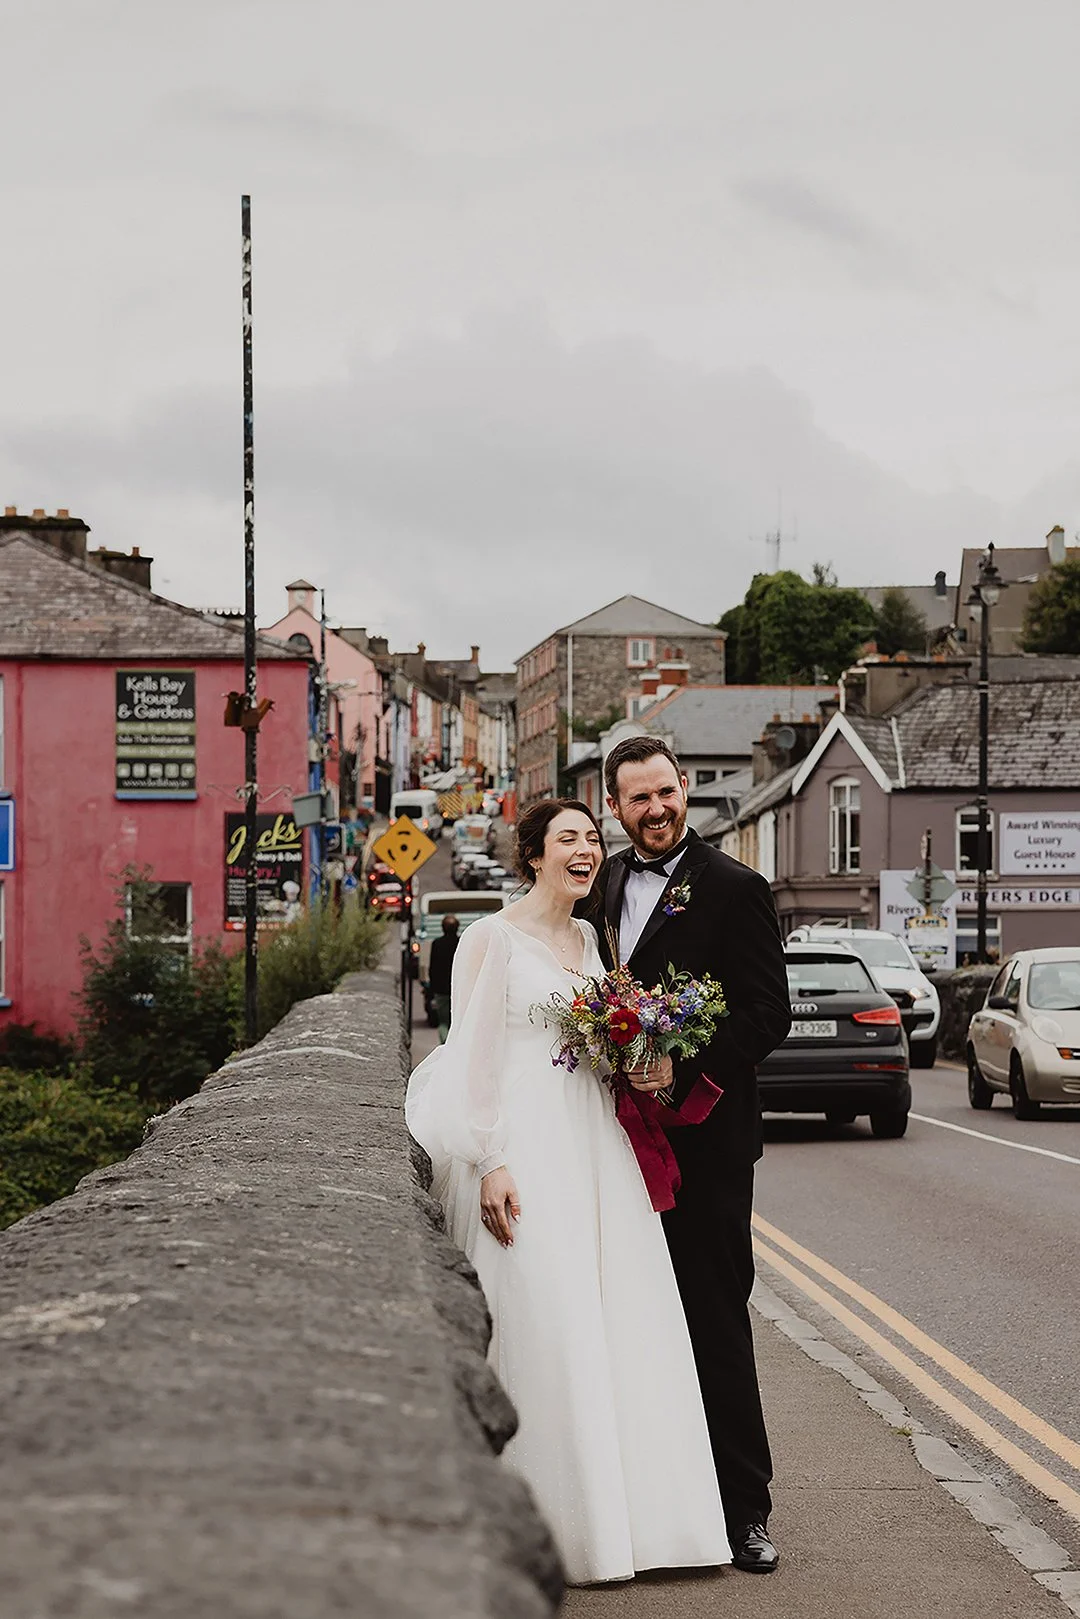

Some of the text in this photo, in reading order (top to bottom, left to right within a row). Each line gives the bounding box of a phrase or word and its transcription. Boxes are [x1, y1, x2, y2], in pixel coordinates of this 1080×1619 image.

[126, 676, 187, 696] Kells Bay
[133, 691, 179, 706] House
[118, 703, 194, 719] & Gardens
[1007, 821, 1039, 830] Award
[226, 814, 302, 864] Jcks
[1028, 836, 1062, 846] Luxury
[1014, 849, 1076, 859] Guest House
[1029, 891, 1072, 902] EDGE
[887, 905, 921, 914] Rivers
